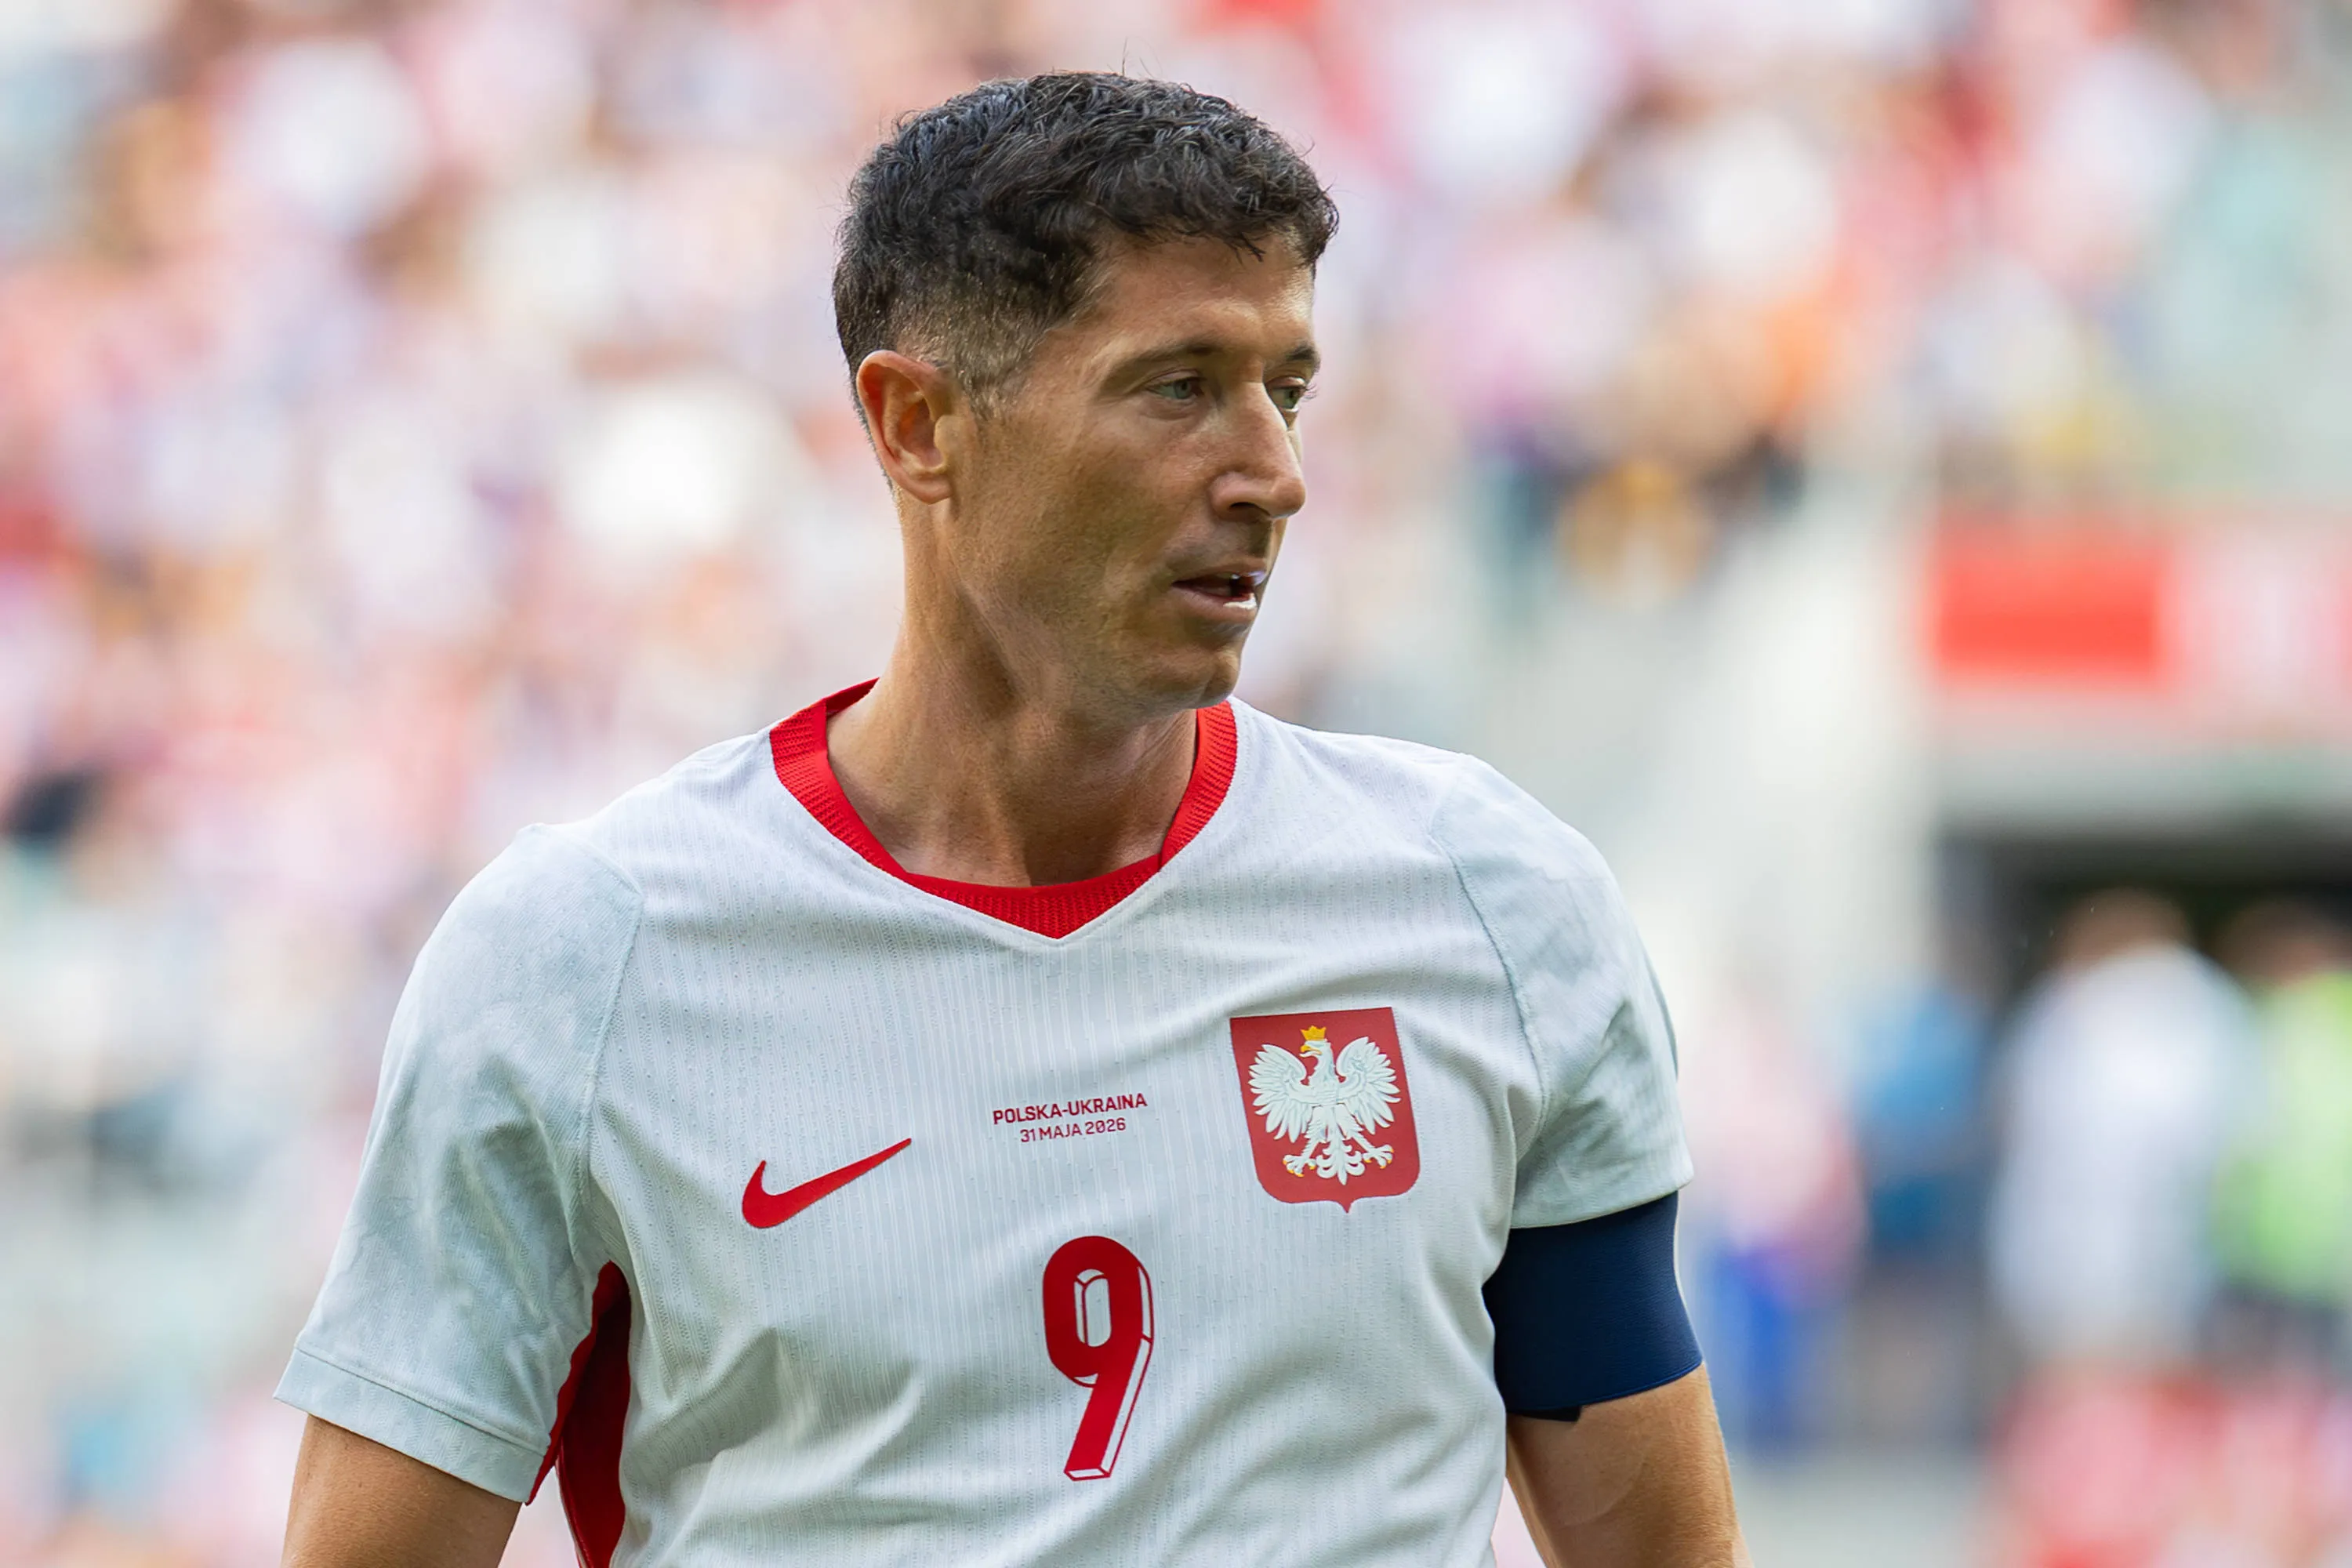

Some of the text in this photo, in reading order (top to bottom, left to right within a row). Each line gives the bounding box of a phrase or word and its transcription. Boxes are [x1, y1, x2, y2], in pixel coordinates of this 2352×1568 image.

[993, 1093, 1147, 1125] POLSKA-UKRAINA
[1020, 1117, 1126, 1142] 31 MAJA 2026
[1043, 1236, 1155, 1482] 9
